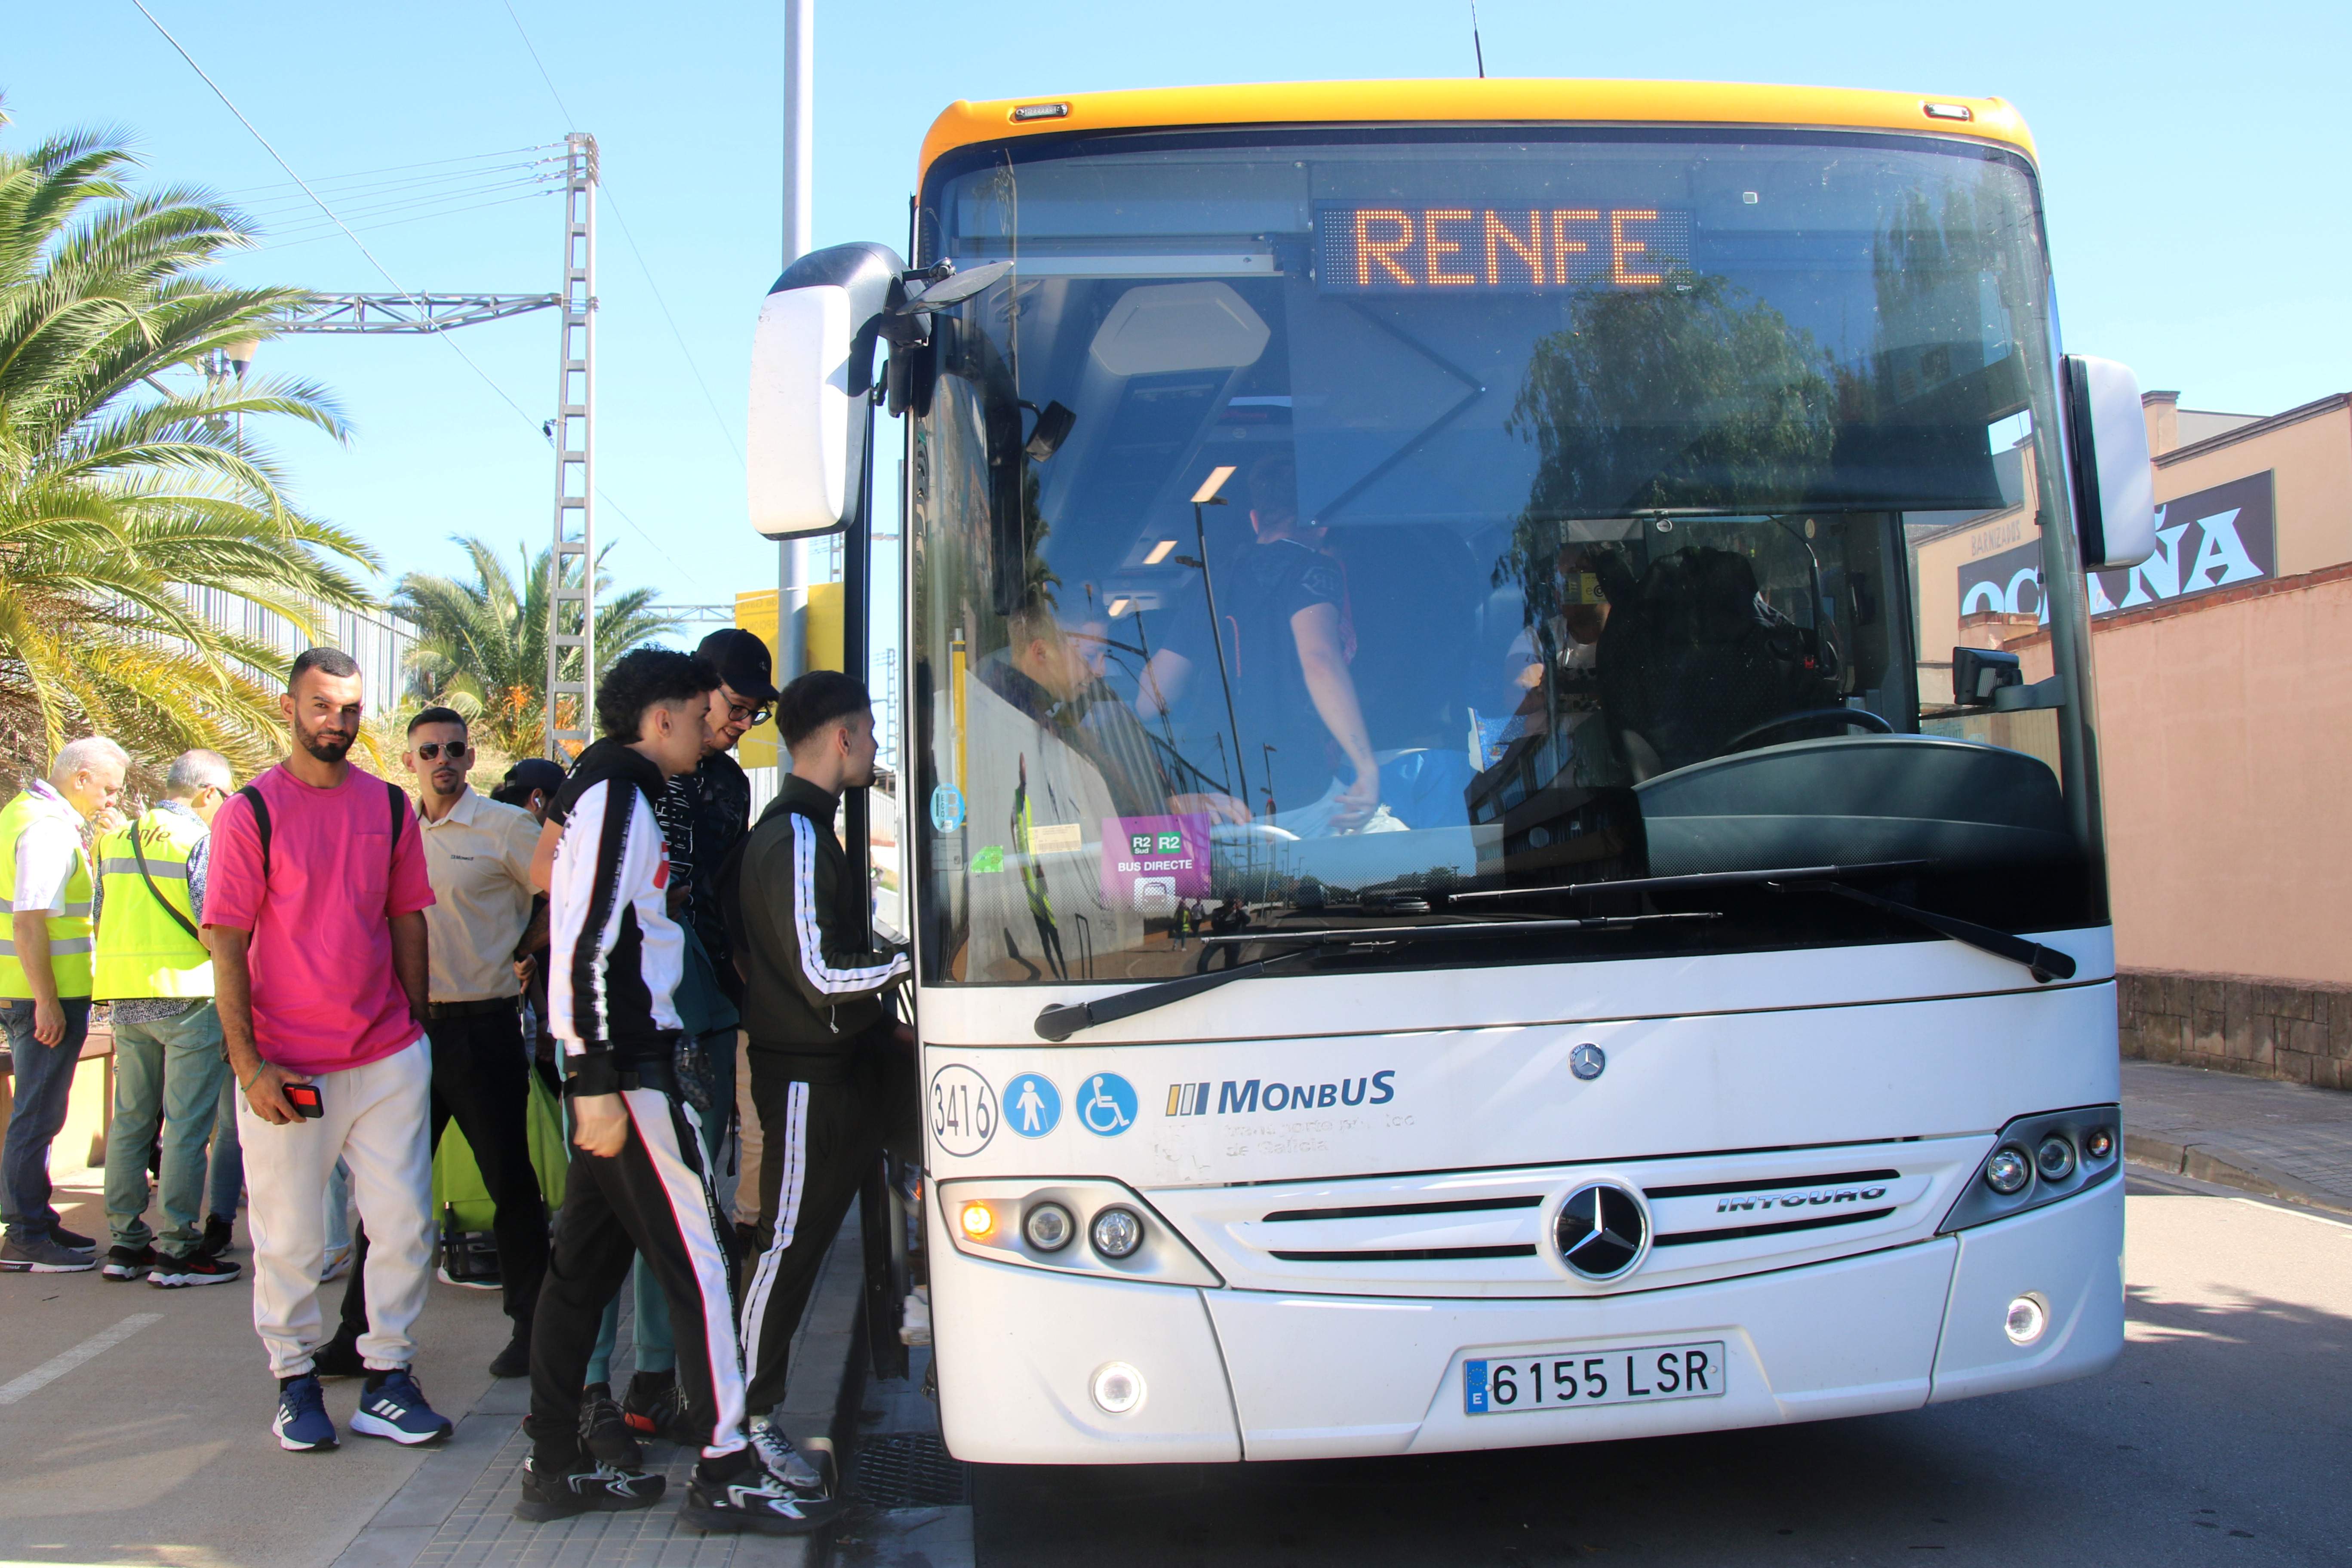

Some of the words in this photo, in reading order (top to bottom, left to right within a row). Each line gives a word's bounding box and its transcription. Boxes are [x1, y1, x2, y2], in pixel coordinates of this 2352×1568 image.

[1356, 209, 1661, 285] RENFE
[1971, 519, 2021, 556] BARNIZADOS
[1133, 837, 1151, 848] R2
[1159, 836, 1180, 849] R2
[1118, 862, 1141, 872] BUS
[1144, 859, 1193, 871] DIRECTE
[935, 1083, 990, 1139] 3416
[1716, 1184, 1887, 1213] INTOURO
[1492, 1358, 1608, 1405] 6155
[1626, 1350, 1708, 1396] LSR
[1473, 1393, 1482, 1405] E
